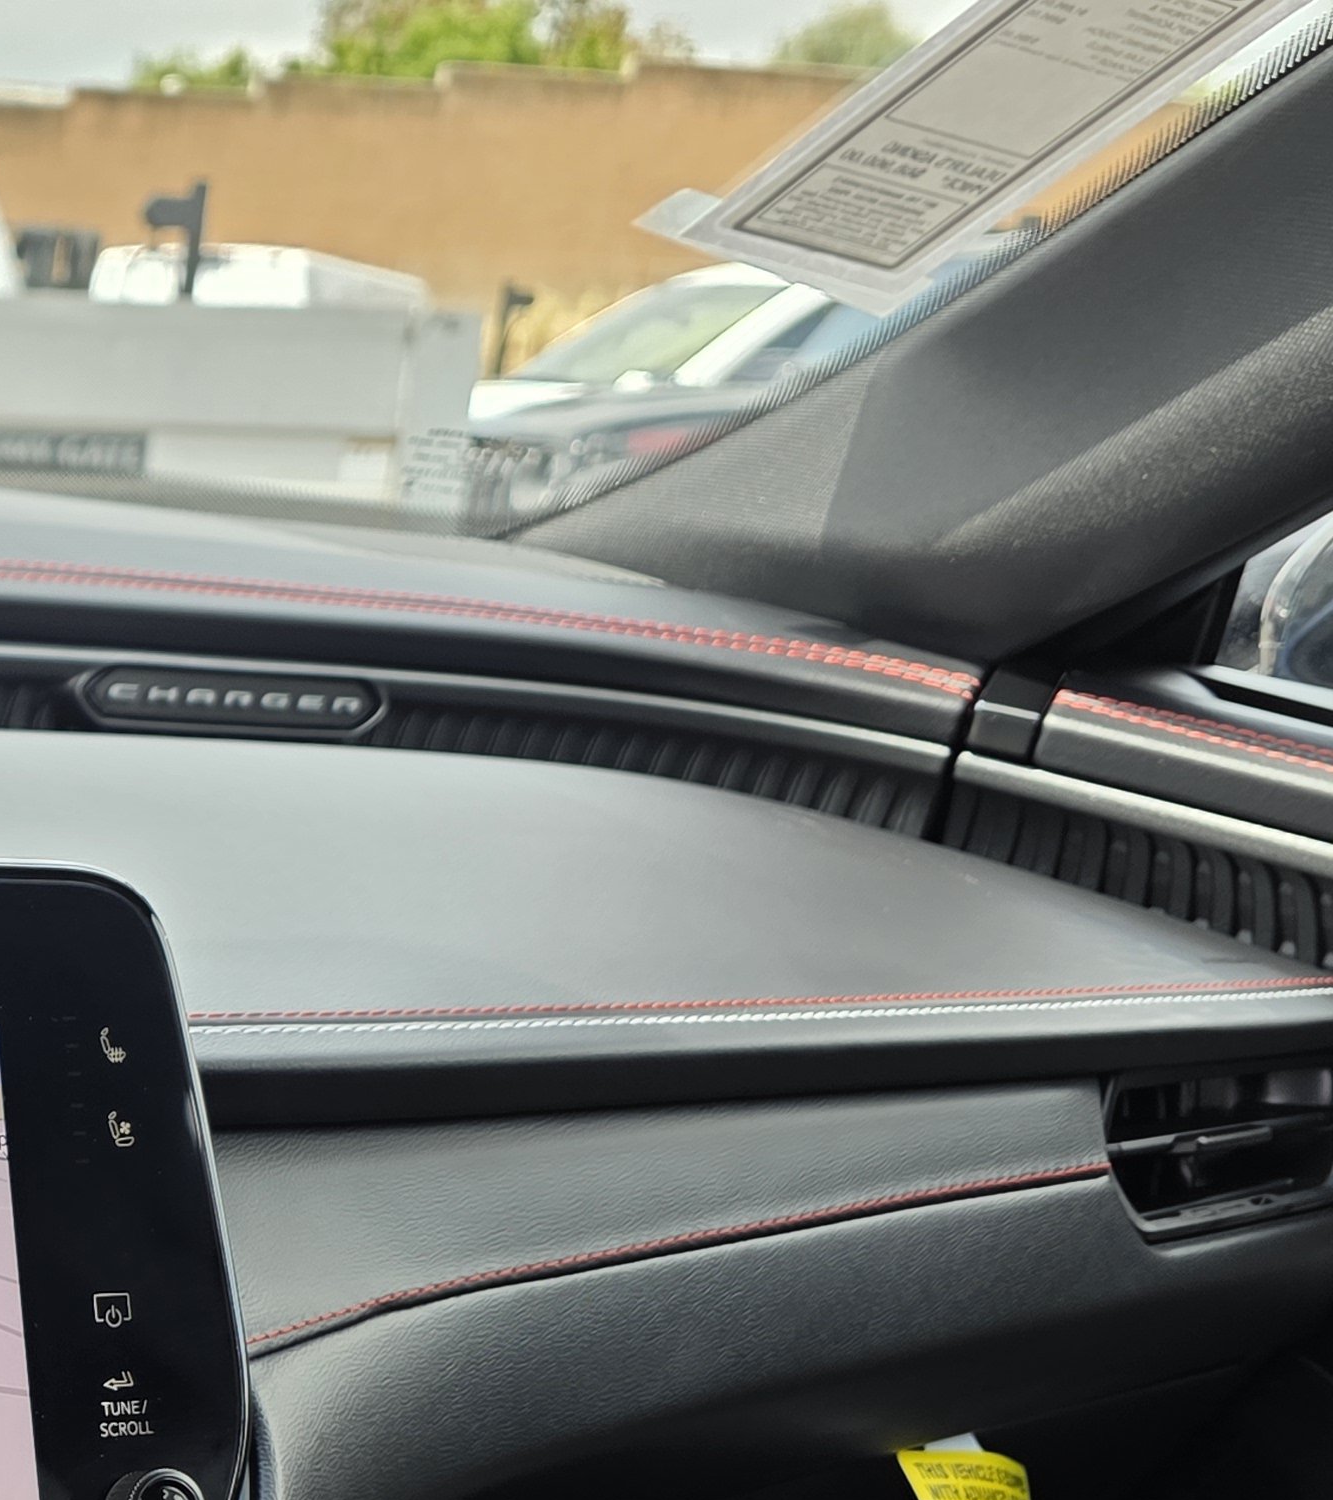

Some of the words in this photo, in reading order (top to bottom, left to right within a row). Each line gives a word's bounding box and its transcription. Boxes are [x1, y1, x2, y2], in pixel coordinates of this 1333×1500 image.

[108, 682, 363, 714] CHARGER
[100, 1400, 148, 1417] TUNE/
[99, 1421, 154, 1438] SCROLL
